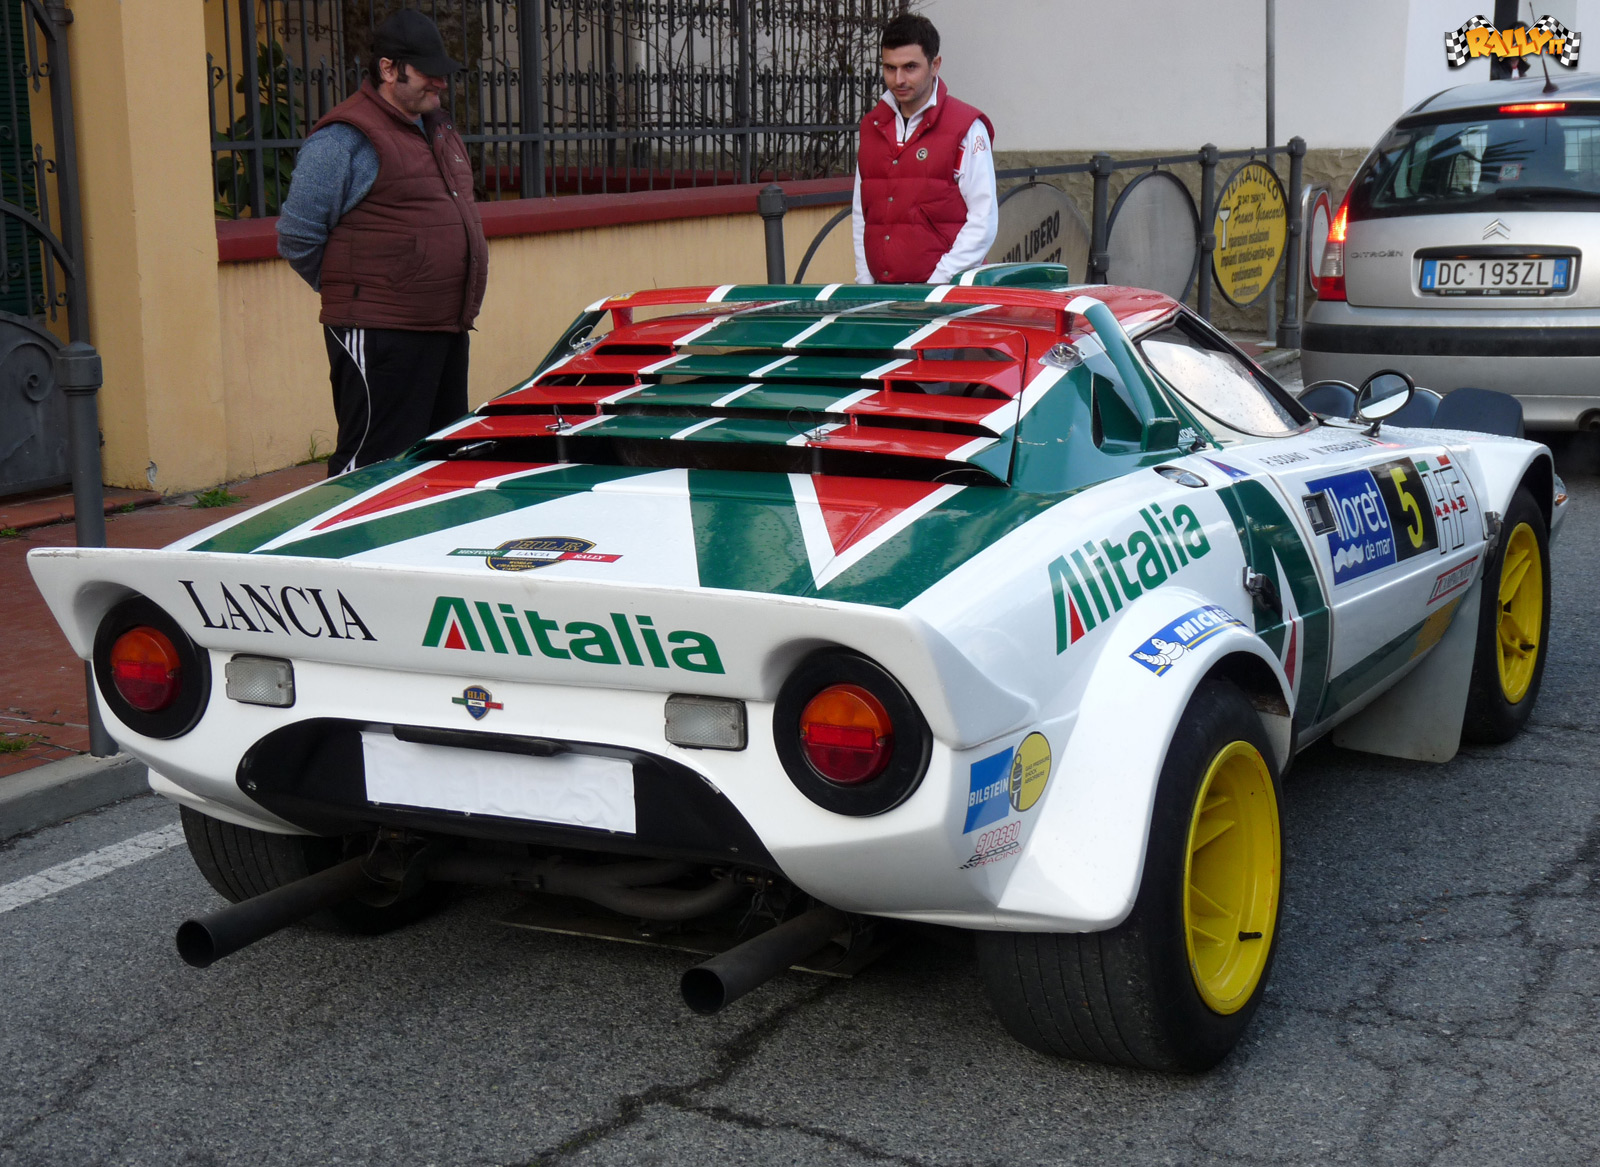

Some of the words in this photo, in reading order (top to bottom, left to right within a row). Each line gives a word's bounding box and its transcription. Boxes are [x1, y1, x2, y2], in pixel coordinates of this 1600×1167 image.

[1227, 165, 1279, 201] IDRAULICO
[1024, 209, 1060, 262] LIBERO
[1438, 262, 1467, 286] DC
[1479, 262, 1550, 285] 193ZL
[1553, 274, 1566, 285] AL
[1324, 482, 1388, 542] lloret
[1390, 466, 1424, 549] 5
[457, 548, 503, 556] HISTORIC
[572, 553, 606, 561] RALLY
[1365, 539, 1376, 561] de
[1375, 538, 1391, 557] mar
[1047, 502, 1212, 656] Alitalia
[178, 579, 378, 643] LANCIA
[422, 595, 727, 675] Alitalia
[968, 776, 1010, 808] BILSTEIN
